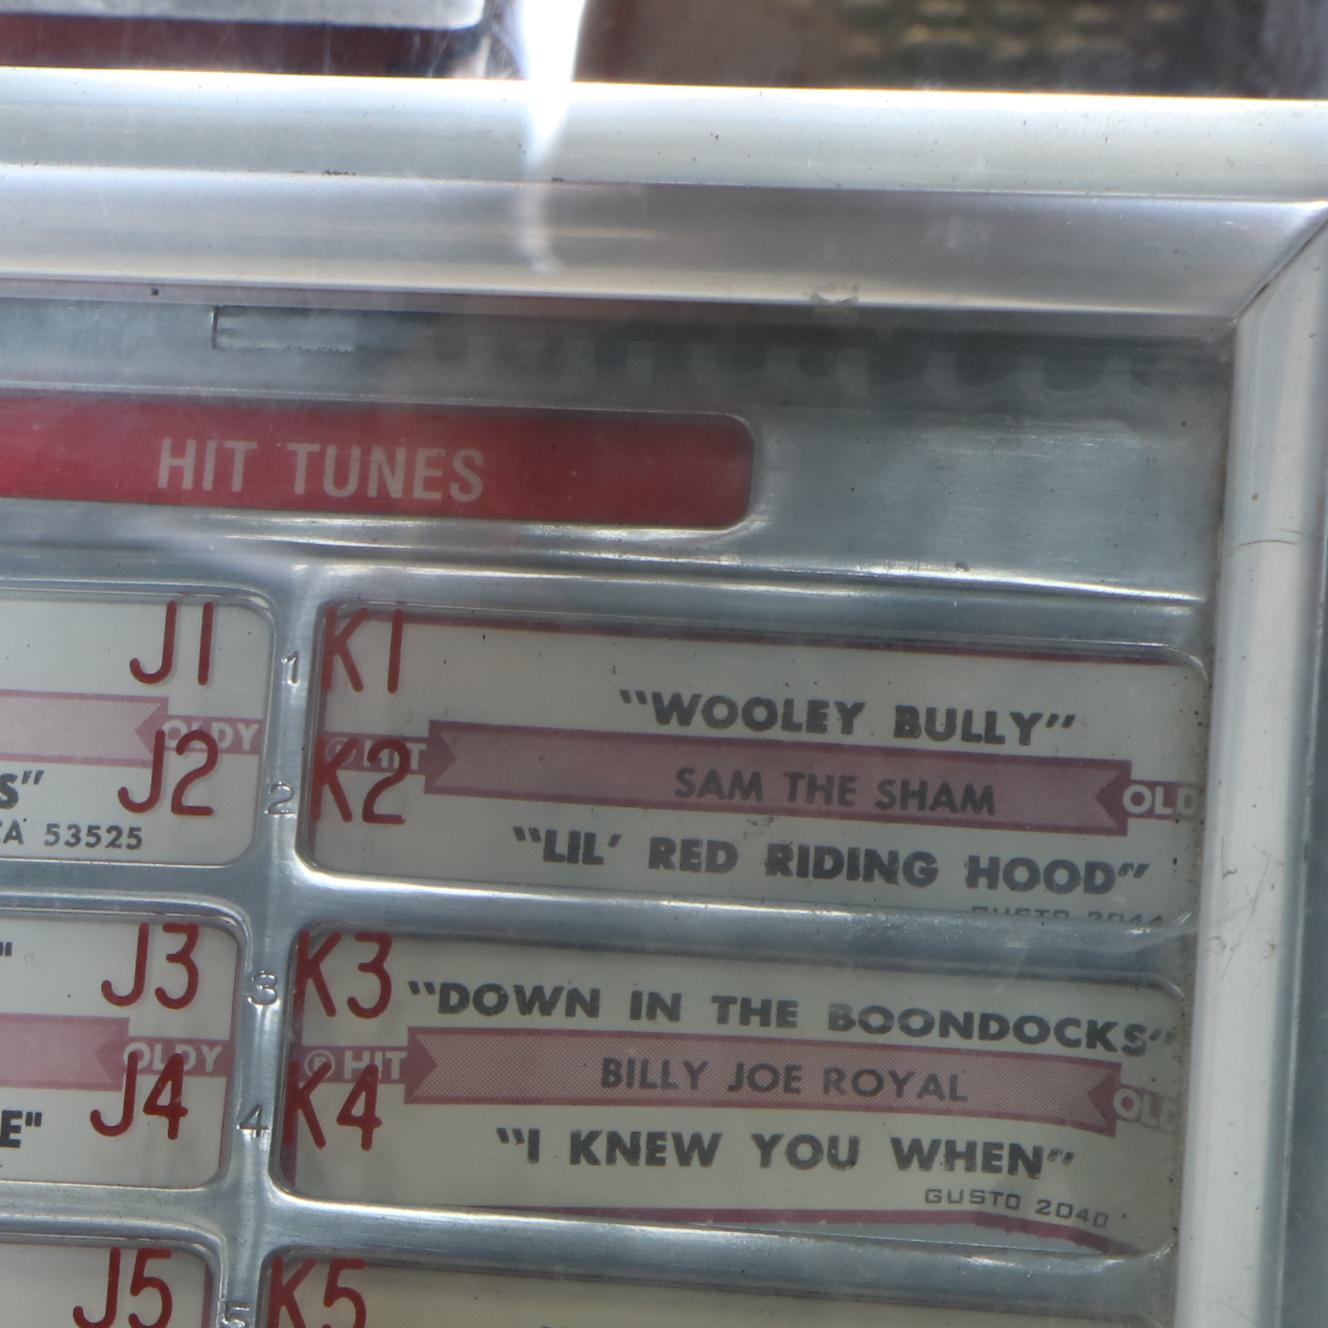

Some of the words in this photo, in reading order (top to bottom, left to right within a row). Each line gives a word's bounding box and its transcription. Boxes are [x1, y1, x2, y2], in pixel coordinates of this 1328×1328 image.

[157, 437, 258, 492] HIT
[286, 442, 484, 502] TUNES
[618, 689, 866, 736] "WOOLEY
[893, 704, 1076, 746] BULLY"
[119, 728, 219, 816] J2
[312, 736, 409, 825] K2
[674, 766, 764, 802] SAM
[784, 771, 857, 806] THE
[874, 778, 996, 816] SHAM
[44, 822, 143, 851] 53525
[90, 1050, 188, 1140] J4
[285, 1061, 382, 1150] K4
[600, 1056, 709, 1091] BILLY
[726, 1062, 802, 1094] JOE
[822, 1066, 968, 1103] ROYAL
[924, 1188, 1022, 1210] GUSTO
[1034, 1199, 1109, 1230] 2040
